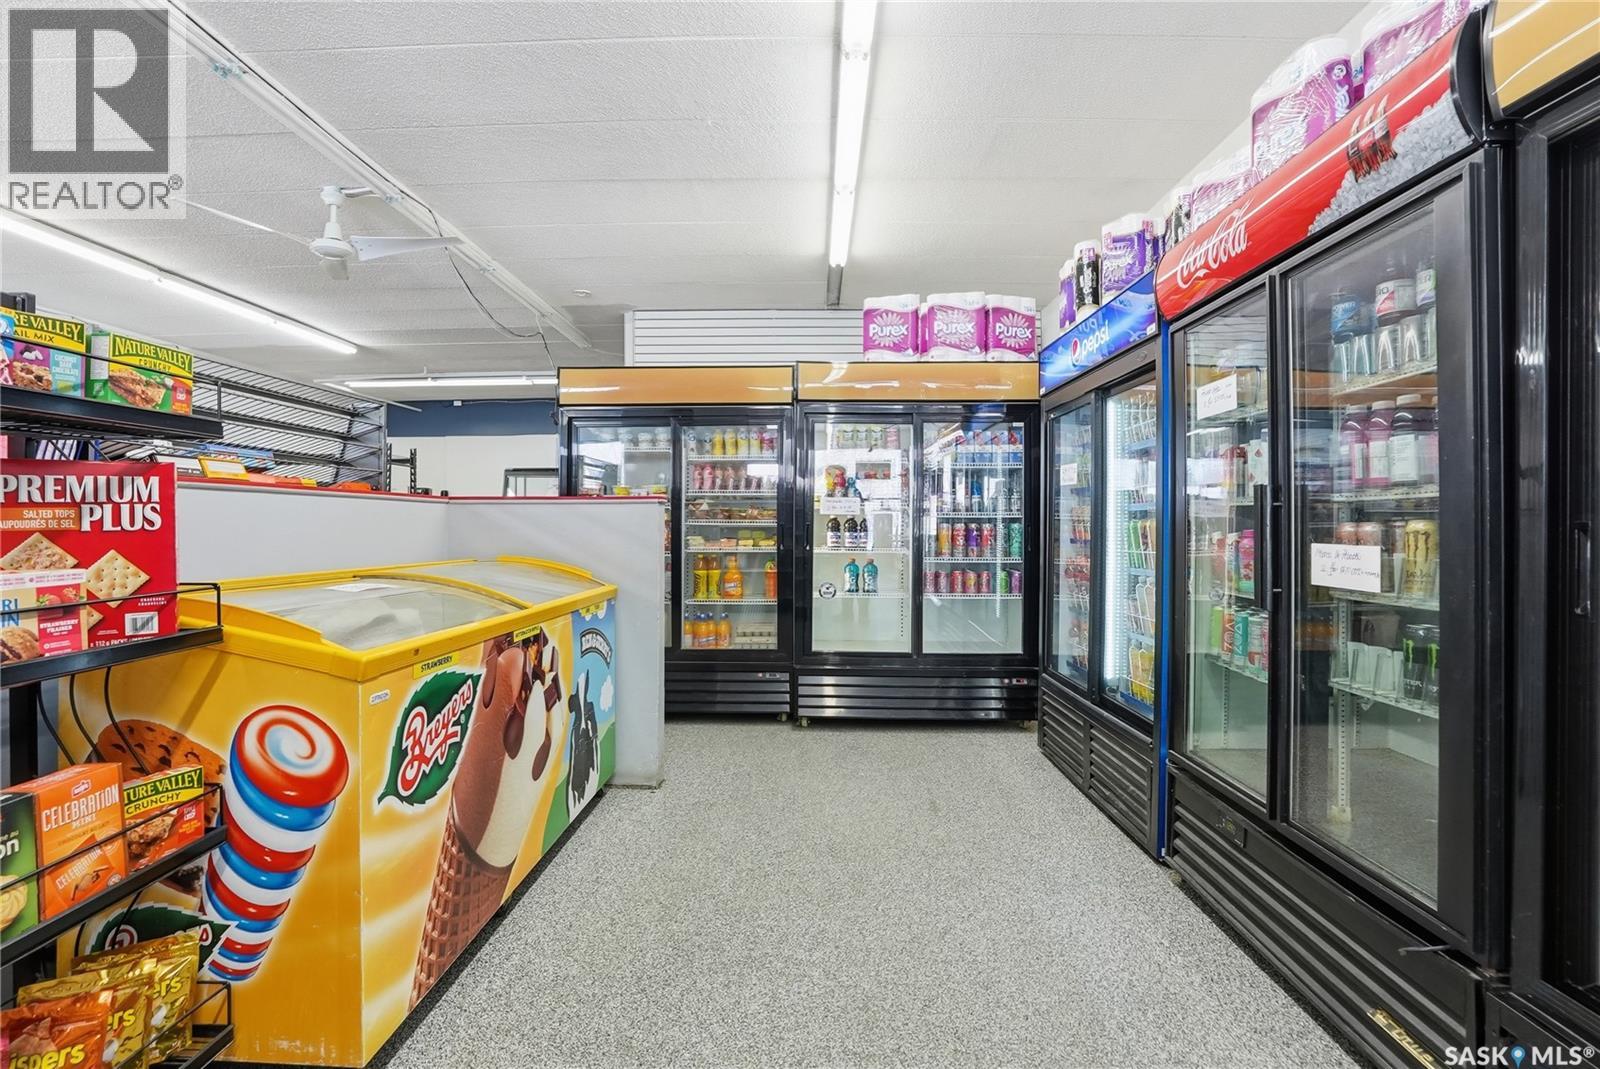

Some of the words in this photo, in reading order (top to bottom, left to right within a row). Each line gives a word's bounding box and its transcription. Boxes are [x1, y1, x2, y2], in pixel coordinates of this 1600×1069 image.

[30, 315, 81, 342] VALLEY
[34, 332, 54, 343] MIX
[869, 323, 909, 338] Purex
[934, 321, 977, 335] Purex
[996, 323, 1033, 339] Purex
[1081, 319, 1110, 359] pepsi
[115, 336, 156, 357] NATURE
[157, 347, 191, 372] VALLEY
[139, 358, 171, 372] CRUNCHY
[0, 475, 160, 503] PREMIUM
[23, 510, 53, 518] SALTED
[55, 510, 75, 518] TOPS
[48, 520, 58, 528] DE
[61, 520, 76, 528] SEL
[81, 504, 162, 532] PLUS
[421, 656, 453, 673] STRAWBERRY
[398, 677, 474, 797] Breyers
[156, 769, 200, 792] VALLEY
[42, 783, 120, 832] CELEBRATION
[126, 792, 182, 815] CRUNCHY
